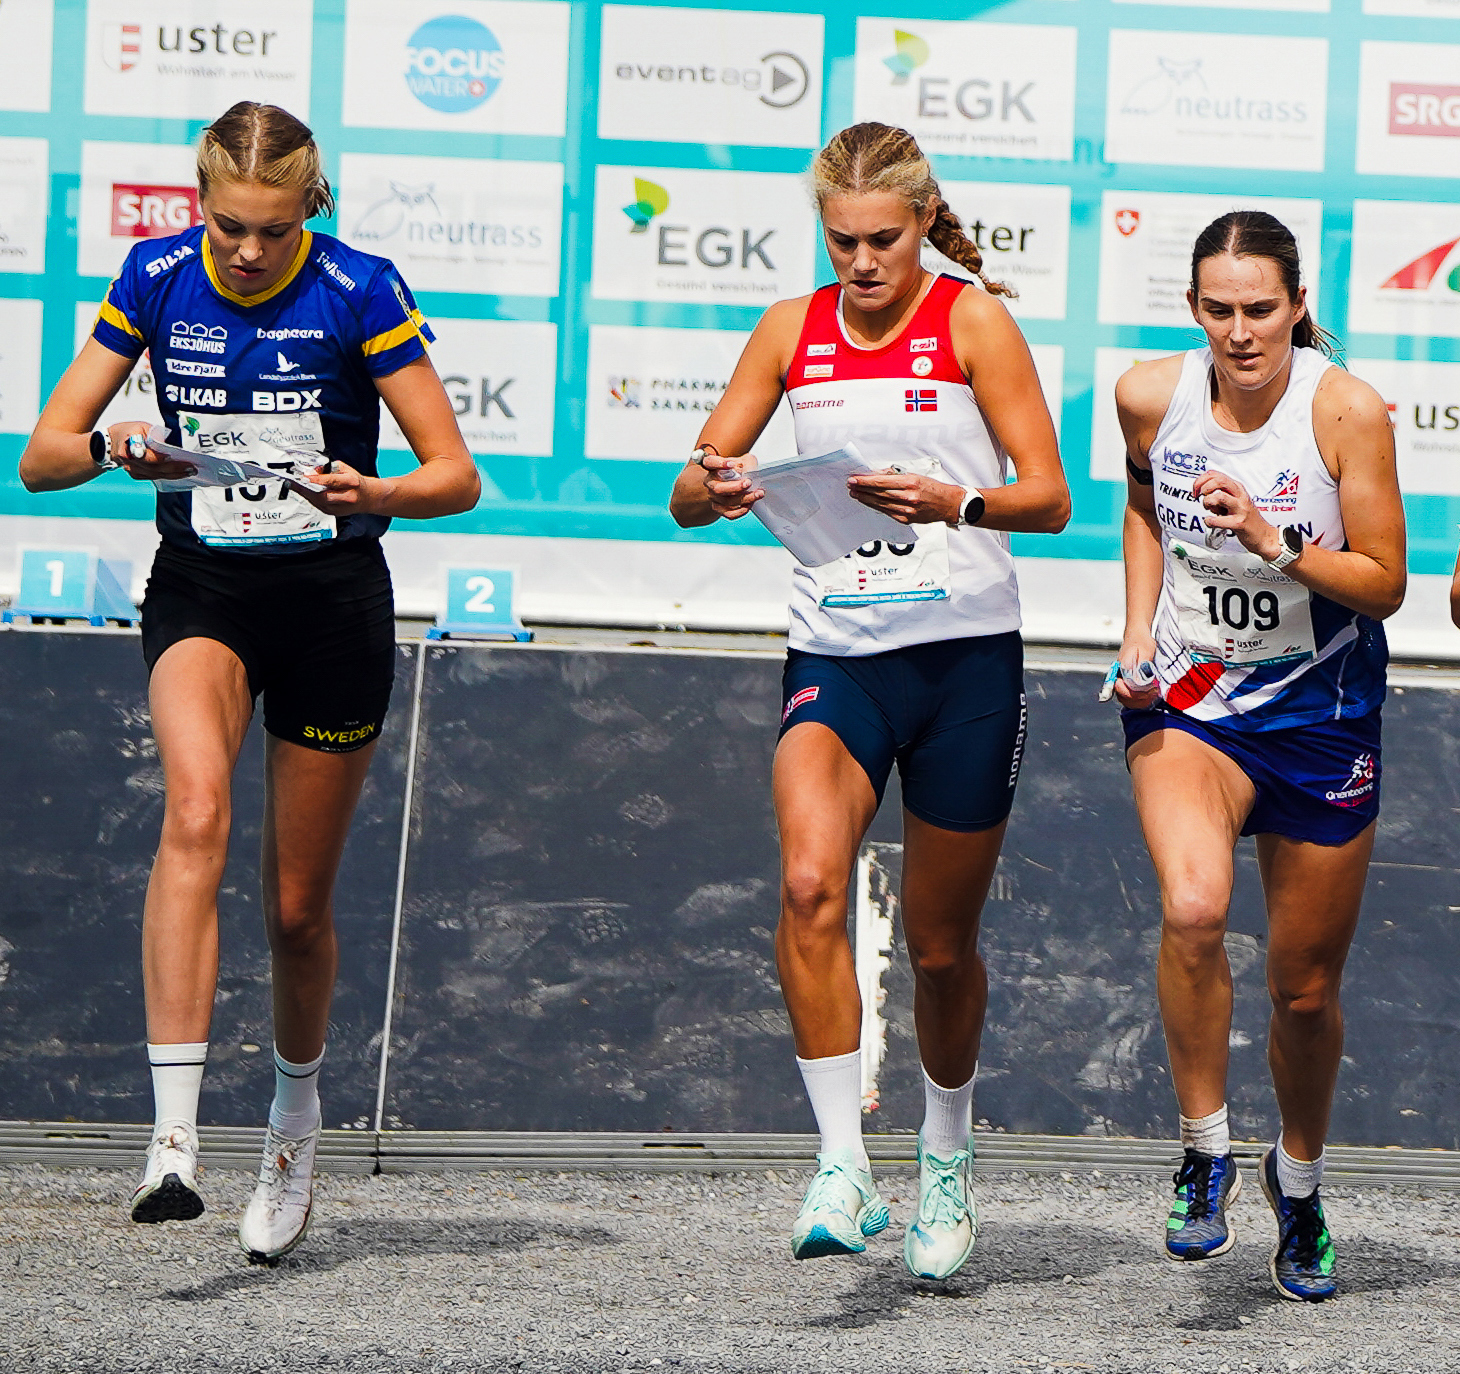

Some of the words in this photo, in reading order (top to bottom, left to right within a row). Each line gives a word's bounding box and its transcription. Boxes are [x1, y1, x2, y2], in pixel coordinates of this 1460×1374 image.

[158, 22, 277, 57] uster
[403, 46, 505, 78] FOCUS
[406, 76, 469, 97] WATER
[616, 63, 761, 91] eventag
[917, 77, 1036, 122] EGK
[1175, 95, 1307, 122] neutrass
[116, 194, 190, 227] SRG
[407, 218, 543, 249] neutrass
[968, 219, 1035, 252] ter
[145, 245, 195, 278] SILVA
[658, 226, 778, 270] EGK
[169, 335, 226, 354] EKSJÖHUS
[256, 327, 324, 341] bagheera
[179, 387, 227, 408] LKAB
[252, 388, 322, 411] BDX
[442, 372, 515, 418] GK
[198, 431, 248, 447] EGK
[1163, 446, 1193, 470] WOC
[1159, 481, 1200, 503] TRIMTEX
[254, 511, 284, 520] uster
[1157, 503, 1207, 534] GREA
[45, 560, 64, 597] 1
[871, 566, 899, 576] uster
[1187, 558, 1235, 577] EGK
[465, 576, 495, 613] 2
[1203, 586, 1280, 631] 109
[1237, 638, 1264, 648] uster
[302, 722, 376, 743] SWEDEN
[1008, 692, 1027, 788] noname
